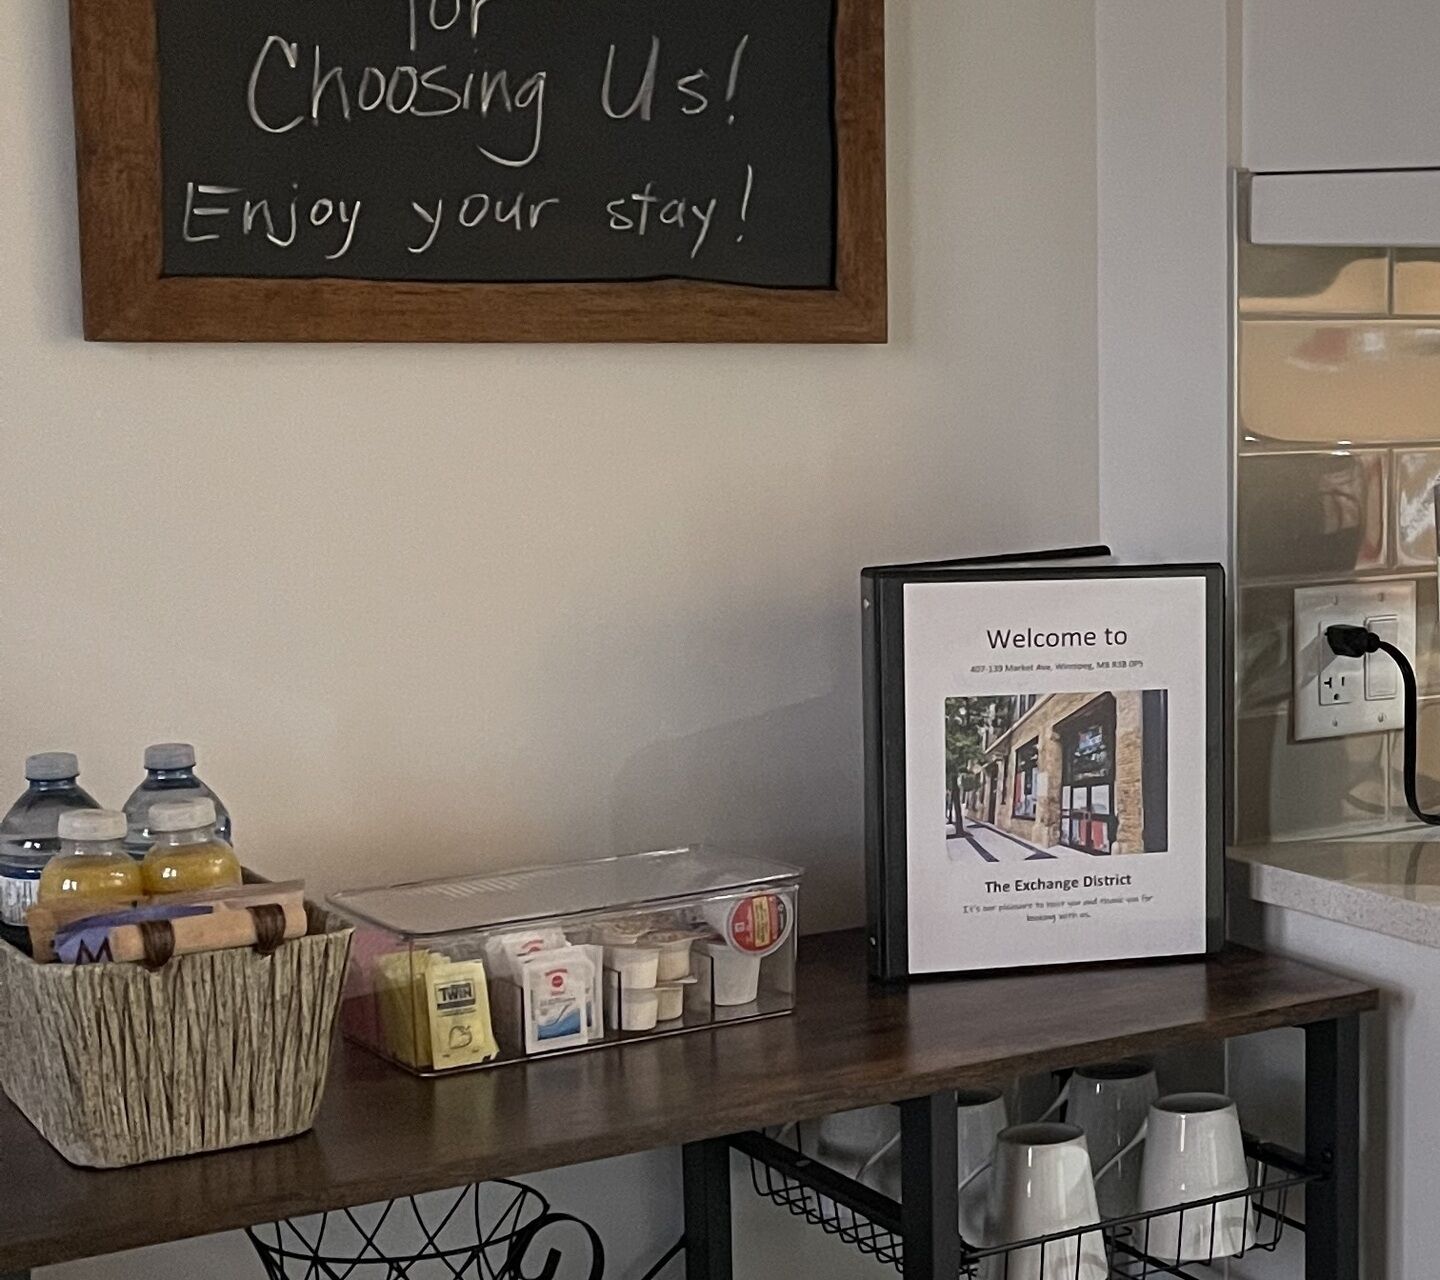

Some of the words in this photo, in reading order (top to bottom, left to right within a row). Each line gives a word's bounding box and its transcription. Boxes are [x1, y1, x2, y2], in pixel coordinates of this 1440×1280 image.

[247, 34, 548, 168] Choosing
[600, 34, 749, 124] Us!
[181, 180, 362, 260] Enjoy
[409, 190, 561, 253] your
[605, 163, 755, 259] stay!
[987, 628, 1096, 648] Welcome
[1105, 628, 1128, 645] to
[985, 881, 1010, 893] The
[1015, 878, 1078, 891] Exchange
[1083, 875, 1132, 887] District
